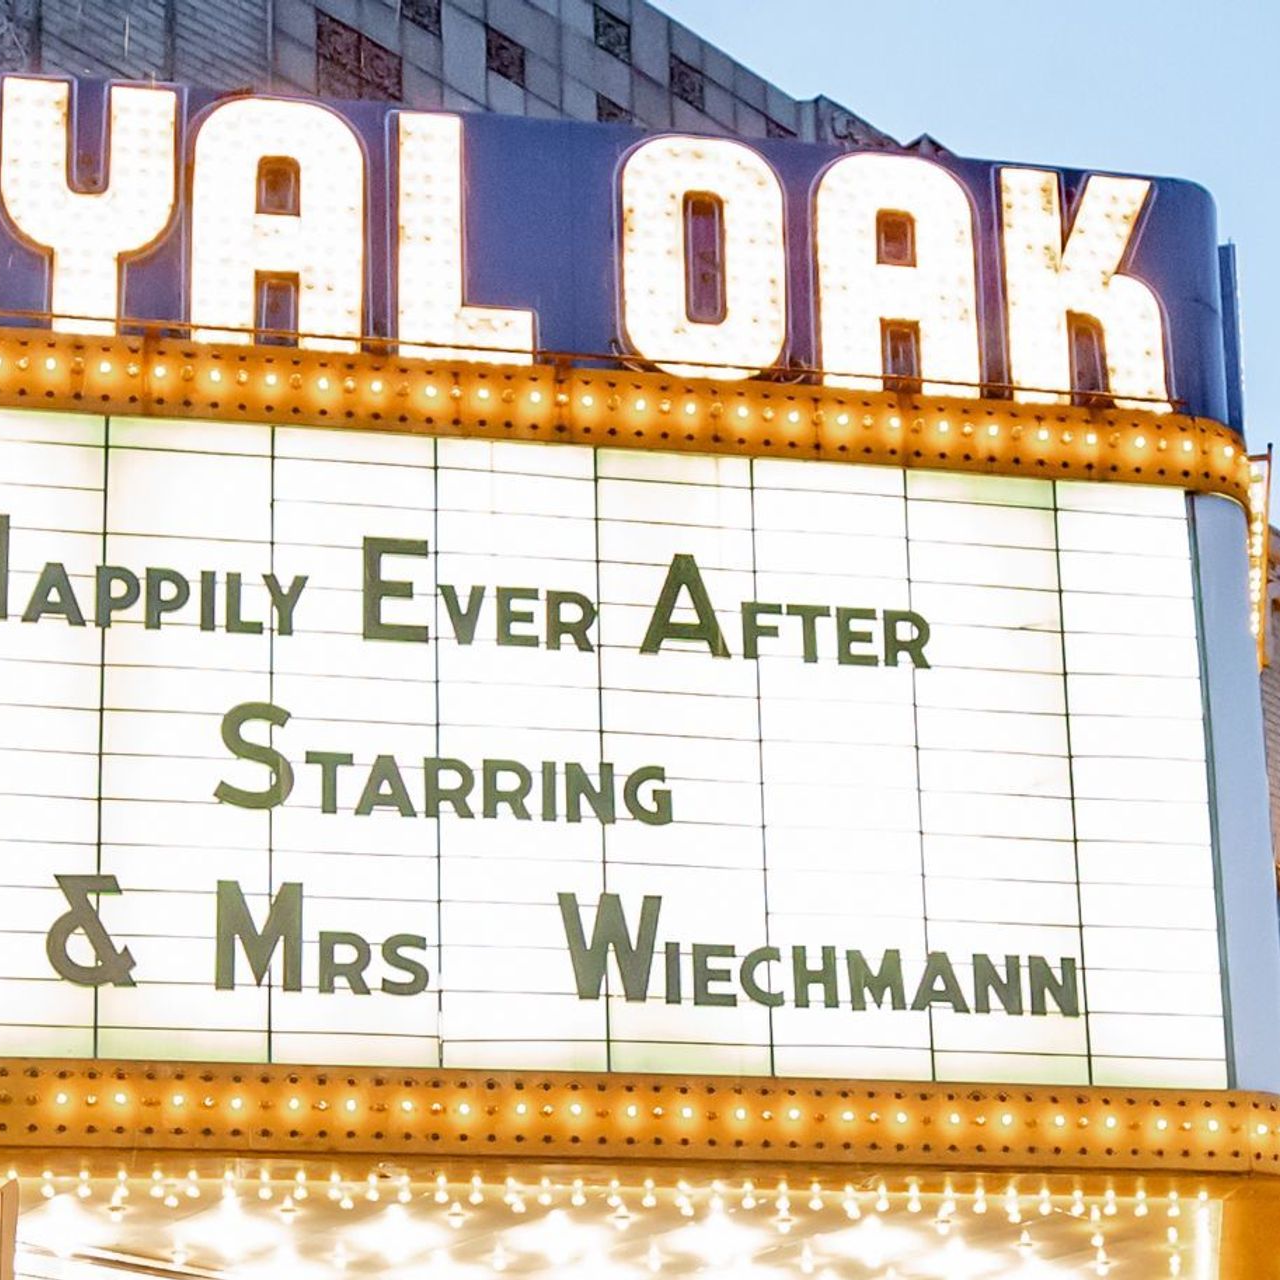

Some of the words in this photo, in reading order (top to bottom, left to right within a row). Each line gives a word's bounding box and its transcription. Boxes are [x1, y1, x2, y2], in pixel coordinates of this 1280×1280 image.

[620, 136, 1175, 414] OAK
[363, 536, 597, 653] EVER
[639, 553, 931, 669] AFTER
[213, 702, 673, 826] STARRING
[46, 874, 137, 987] &
[557, 892, 1080, 1017] WIECHMANN
